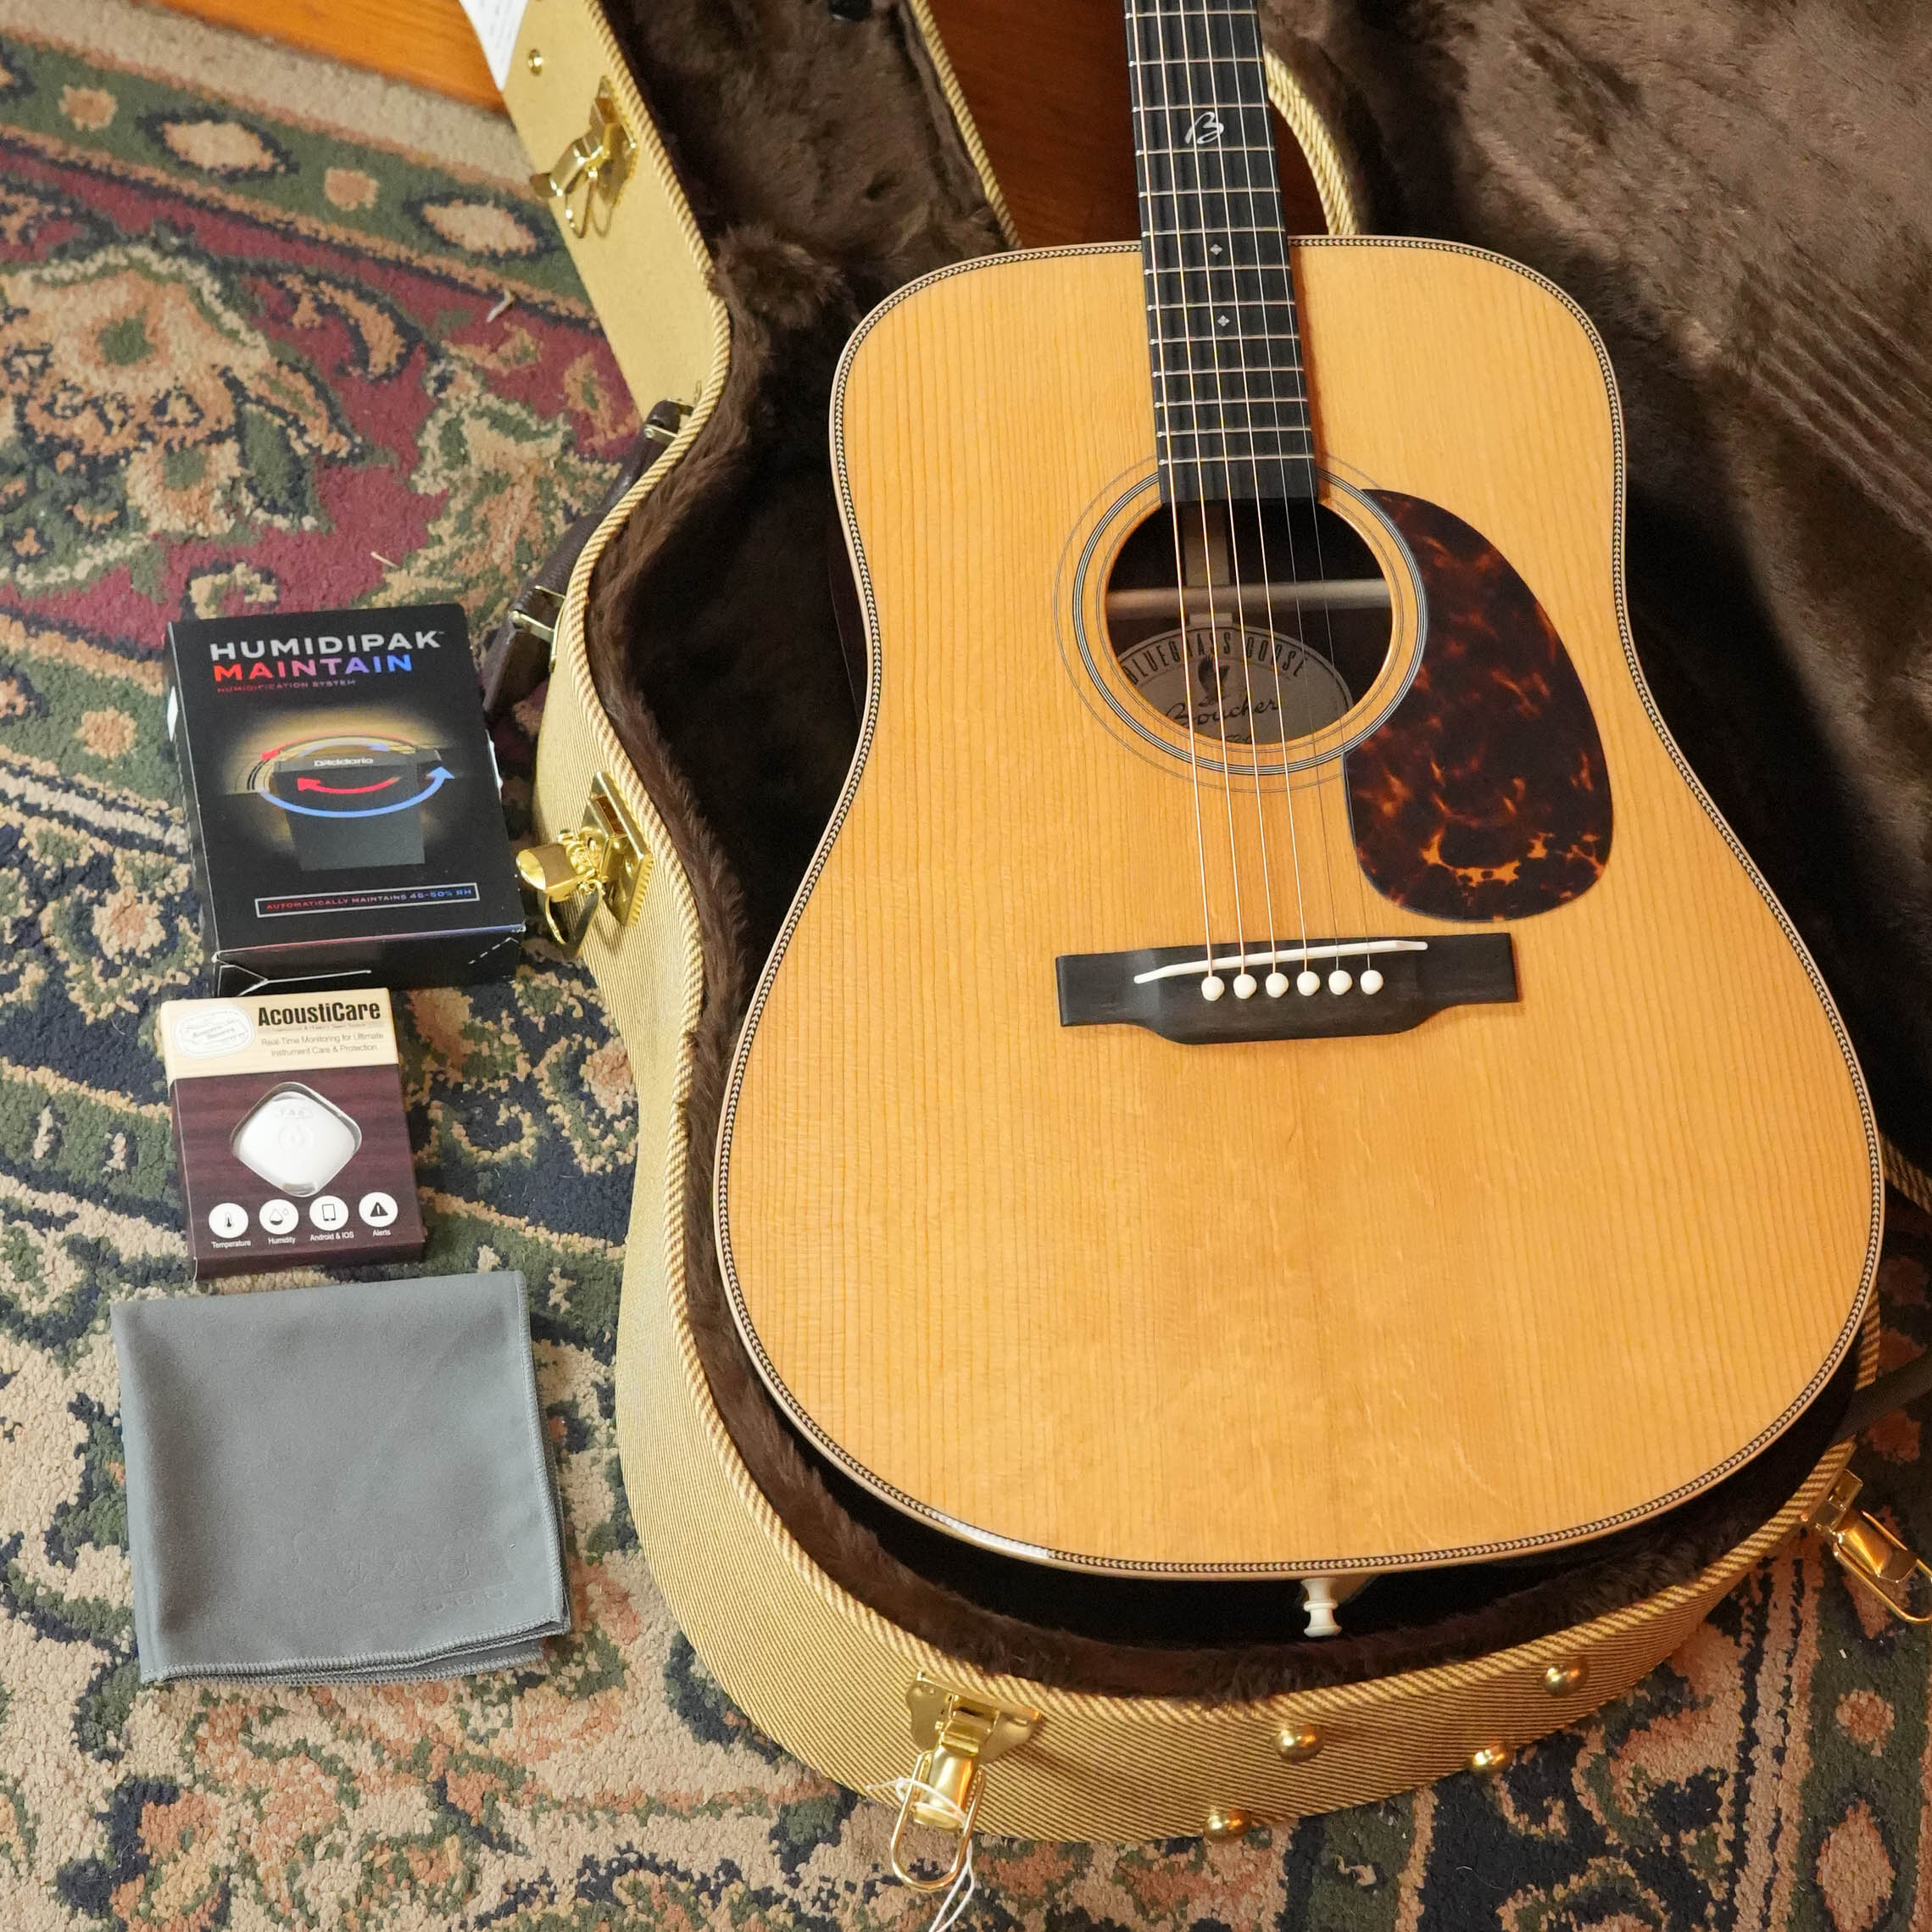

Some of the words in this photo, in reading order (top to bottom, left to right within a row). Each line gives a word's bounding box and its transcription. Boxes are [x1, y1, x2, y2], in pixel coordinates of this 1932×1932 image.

[214, 654, 413, 682] MAINTAIN
[265, 898, 348, 910] AUTOMATICALLY
[258, 1001, 381, 1027] AcoustiCare
[340, 1044, 377, 1053] Protection
[309, 1232, 335, 1242] Android
[372, 1228, 392, 1237] Alerts
[211, 1239, 252, 1250] Temperature
[268, 1236, 297, 1246] Humidity
